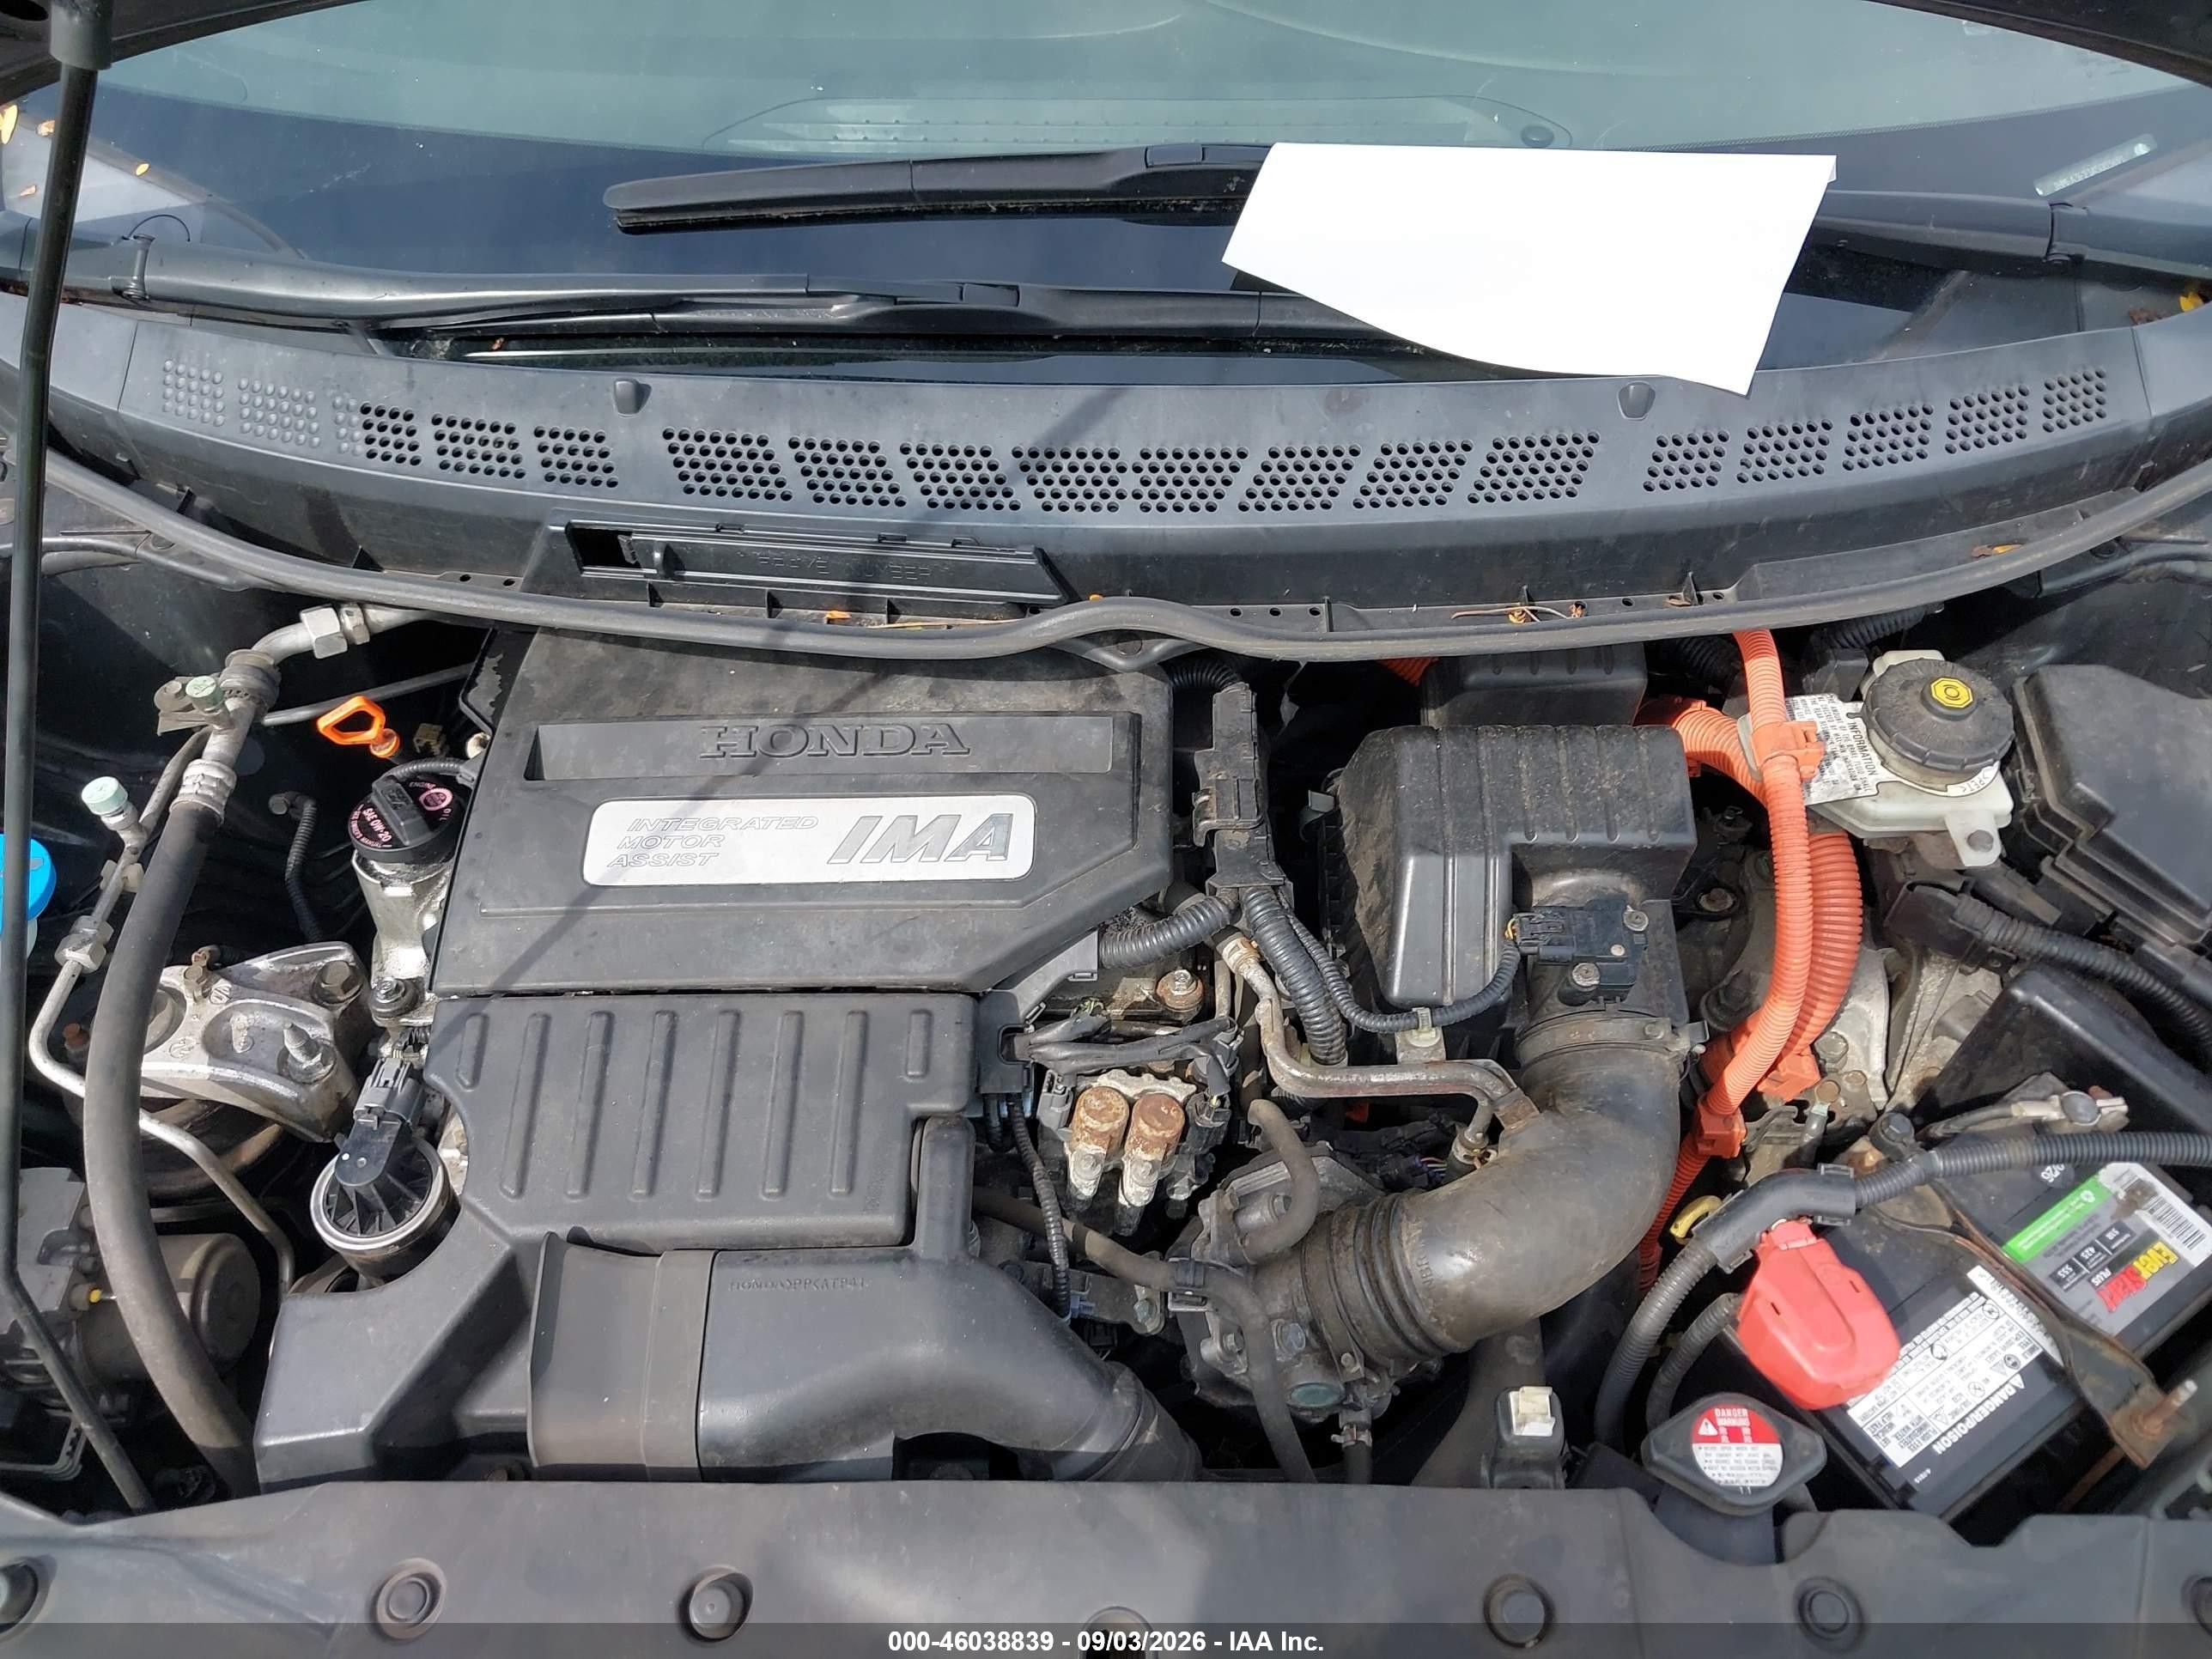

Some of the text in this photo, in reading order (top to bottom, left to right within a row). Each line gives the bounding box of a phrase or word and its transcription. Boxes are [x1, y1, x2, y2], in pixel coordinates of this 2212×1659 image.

[699, 723, 970, 759] HONDA
[1847, 721, 1878, 775] INFORMATION
[362, 808, 378, 822] SAE
[440, 808, 452, 822] OIL
[626, 816, 818, 831] INTEGRATED
[617, 834, 726, 850] MOTOR
[827, 812, 1014, 864] IMA
[607, 852, 721, 867] ASSIST
[2057, 1264, 2074, 1279] 555
[2091, 1267, 2112, 1287] PLUS
[2096, 1241, 2179, 1314] EverStart
[1714, 1408, 1749, 1417] DANGER
[1932, 1383, 2016, 1455] DANGER/POISON
